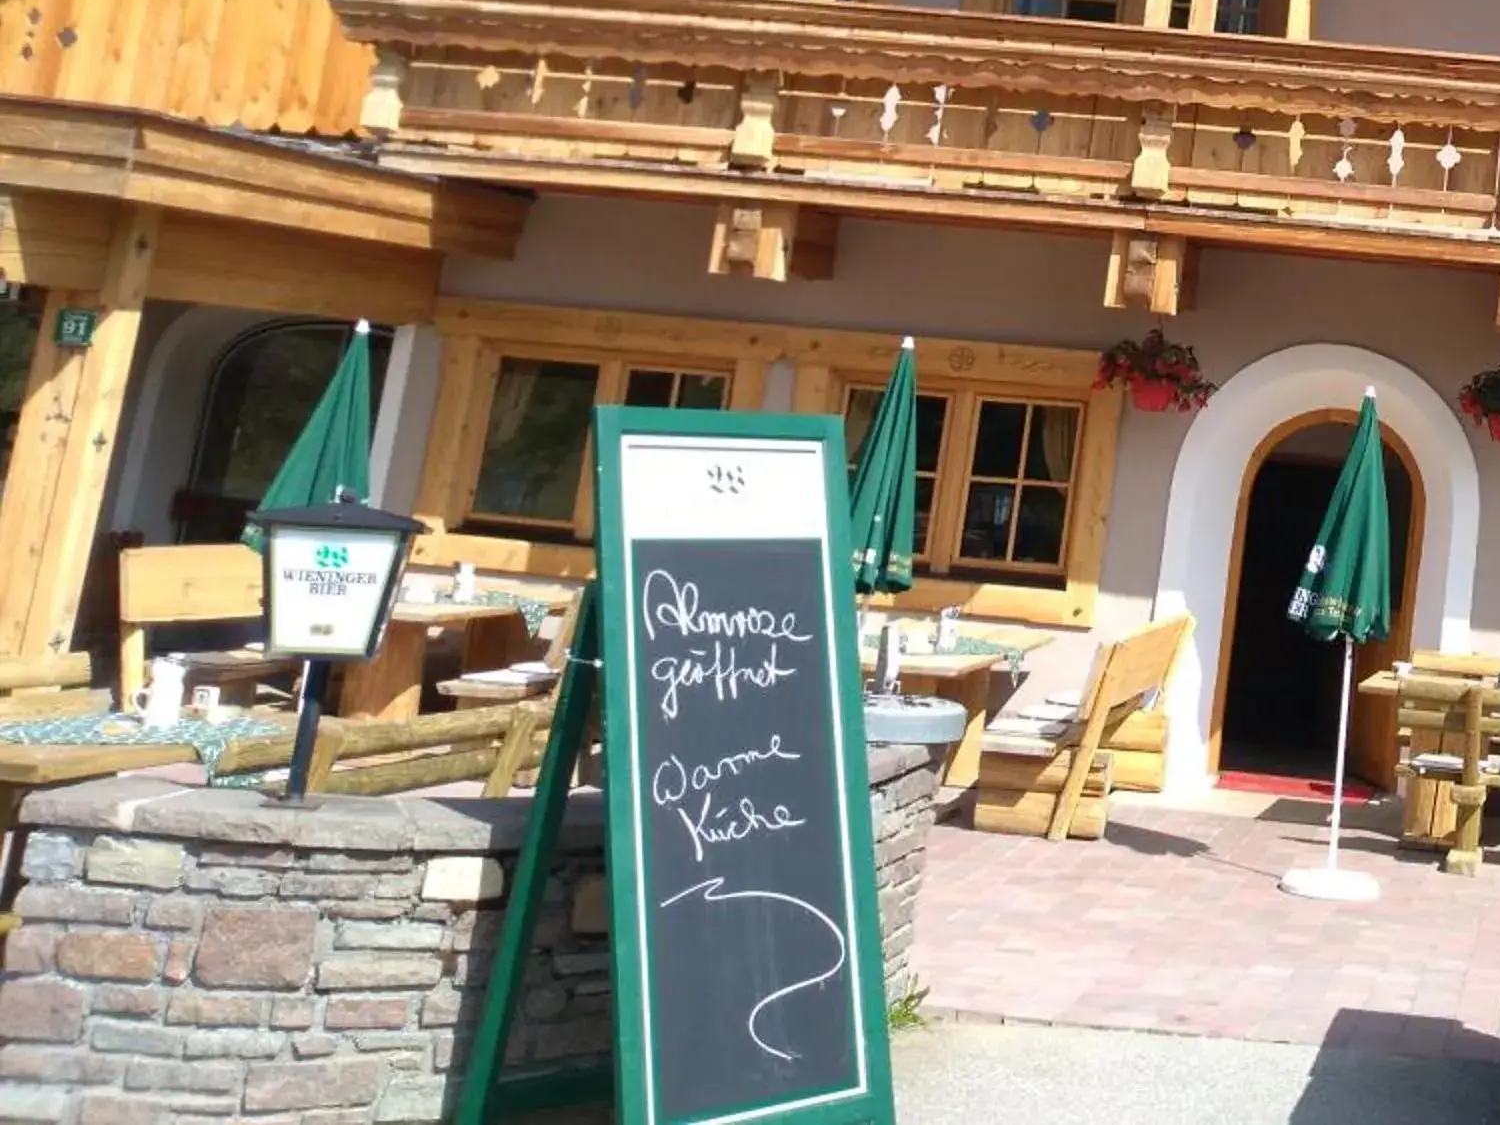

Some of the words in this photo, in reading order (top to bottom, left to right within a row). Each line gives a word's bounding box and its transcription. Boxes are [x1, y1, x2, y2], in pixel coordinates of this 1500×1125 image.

[283, 568, 378, 585] WIENINGER
[309, 581, 347, 596] BIER
[651, 640, 797, 720] geöffnet
[653, 734, 801, 806] Warme
[677, 792, 807, 862] Küche
